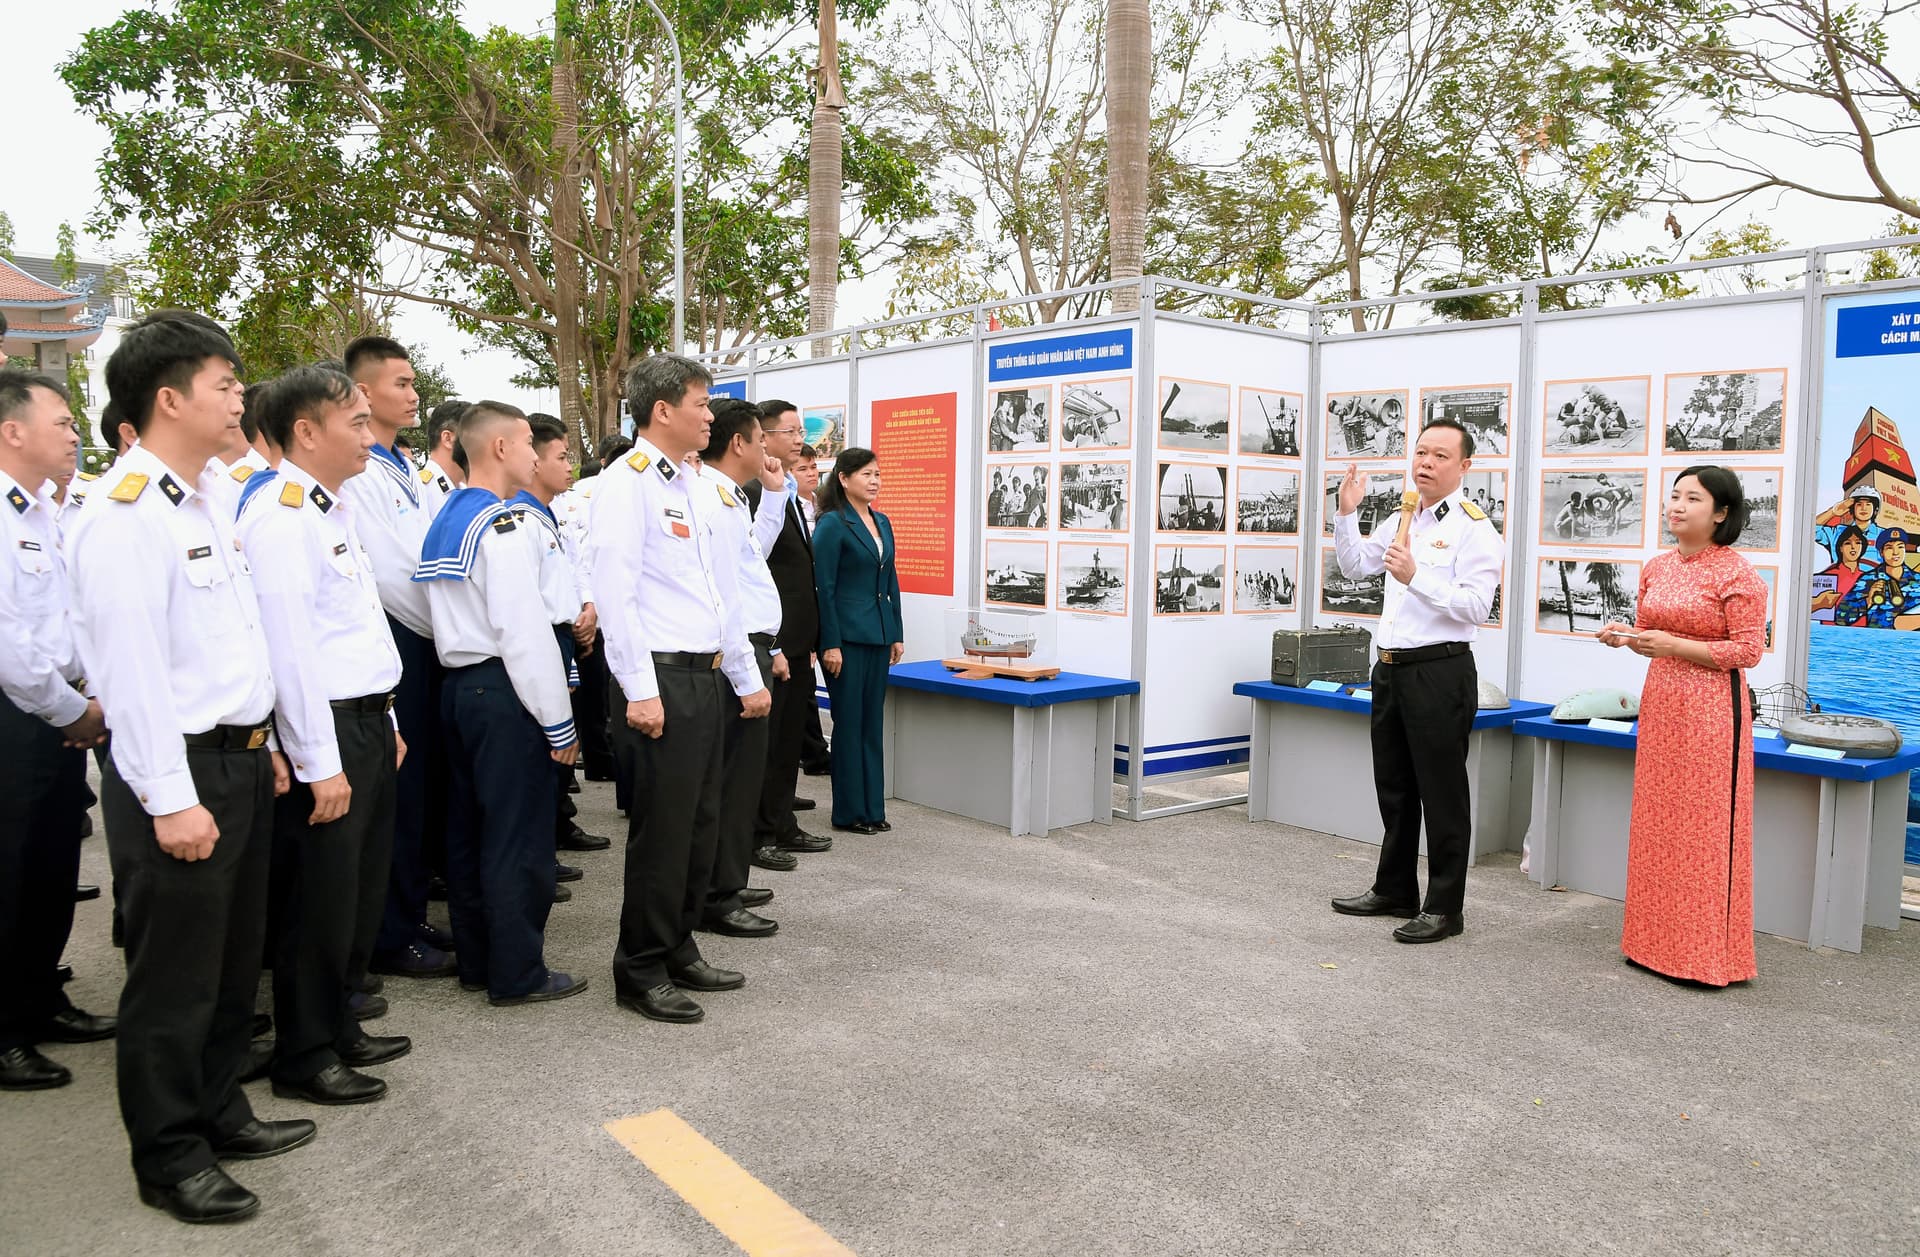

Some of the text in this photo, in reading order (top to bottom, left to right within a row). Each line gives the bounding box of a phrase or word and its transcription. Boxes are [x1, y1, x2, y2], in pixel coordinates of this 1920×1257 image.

[1891, 312, 1911, 327] XÂY
[1881, 330, 1908, 344] CÁCH
[1075, 346, 1085, 363] VIỆT
[1086, 347, 1097, 360] NAM
[1098, 345, 1109, 358] ANH
